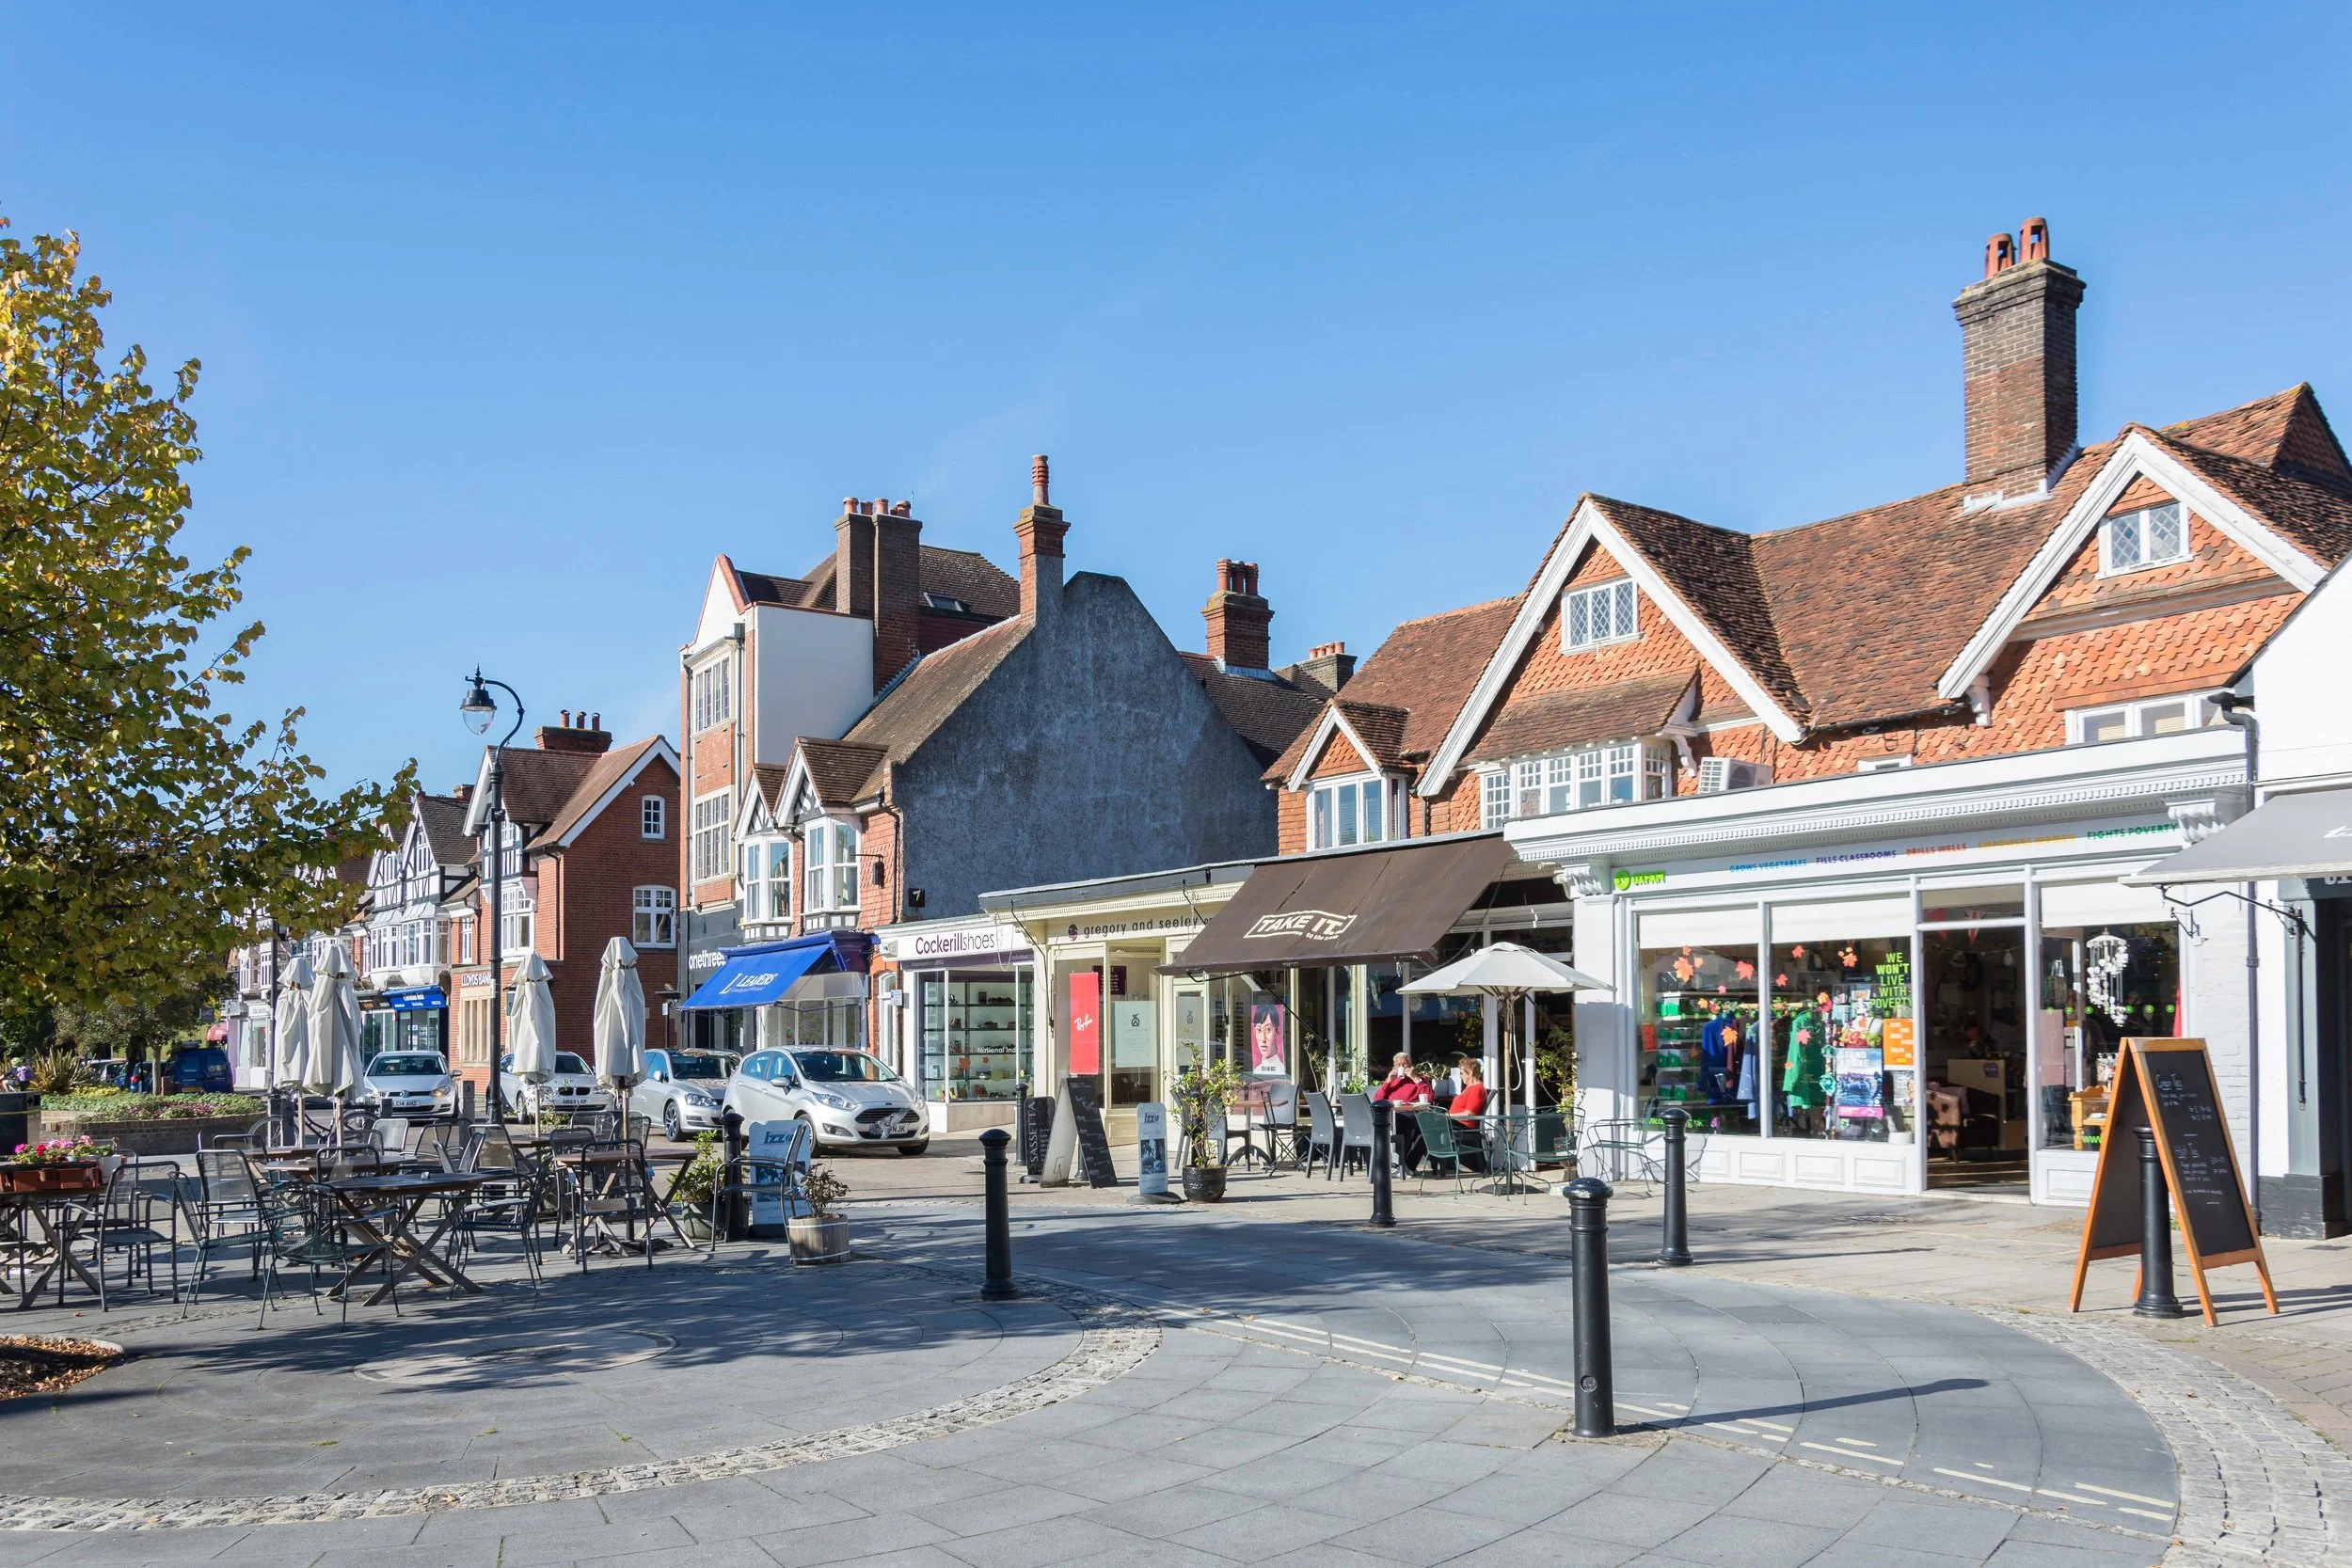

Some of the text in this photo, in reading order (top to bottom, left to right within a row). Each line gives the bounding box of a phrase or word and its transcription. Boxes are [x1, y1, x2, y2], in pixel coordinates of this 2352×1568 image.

[2087, 823, 2178, 840] FIGHTS POVERTY
[1816, 849, 1897, 864] FILLS CLASSROOMS
[1906, 843, 1967, 856] DRILLS WELLS
[1729, 858, 1807, 873] GROWS VEGETABLES
[1084, 924, 1126, 939] gregory
[1132, 920, 1153, 931] and
[1159, 915, 1199, 929] seeley
[1257, 915, 1314, 932] TAKE
[1885, 952, 1903, 963] WE
[1876, 963, 1910, 975] WON'T
[736, 973, 779, 987] LEADERS
[1881, 974, 1905, 987] LIVE
[1879, 986, 1907, 997] WITH
[1869, 998, 1913, 1009] POVERTY
[1027, 1101, 1039, 1163] SASSETTA
